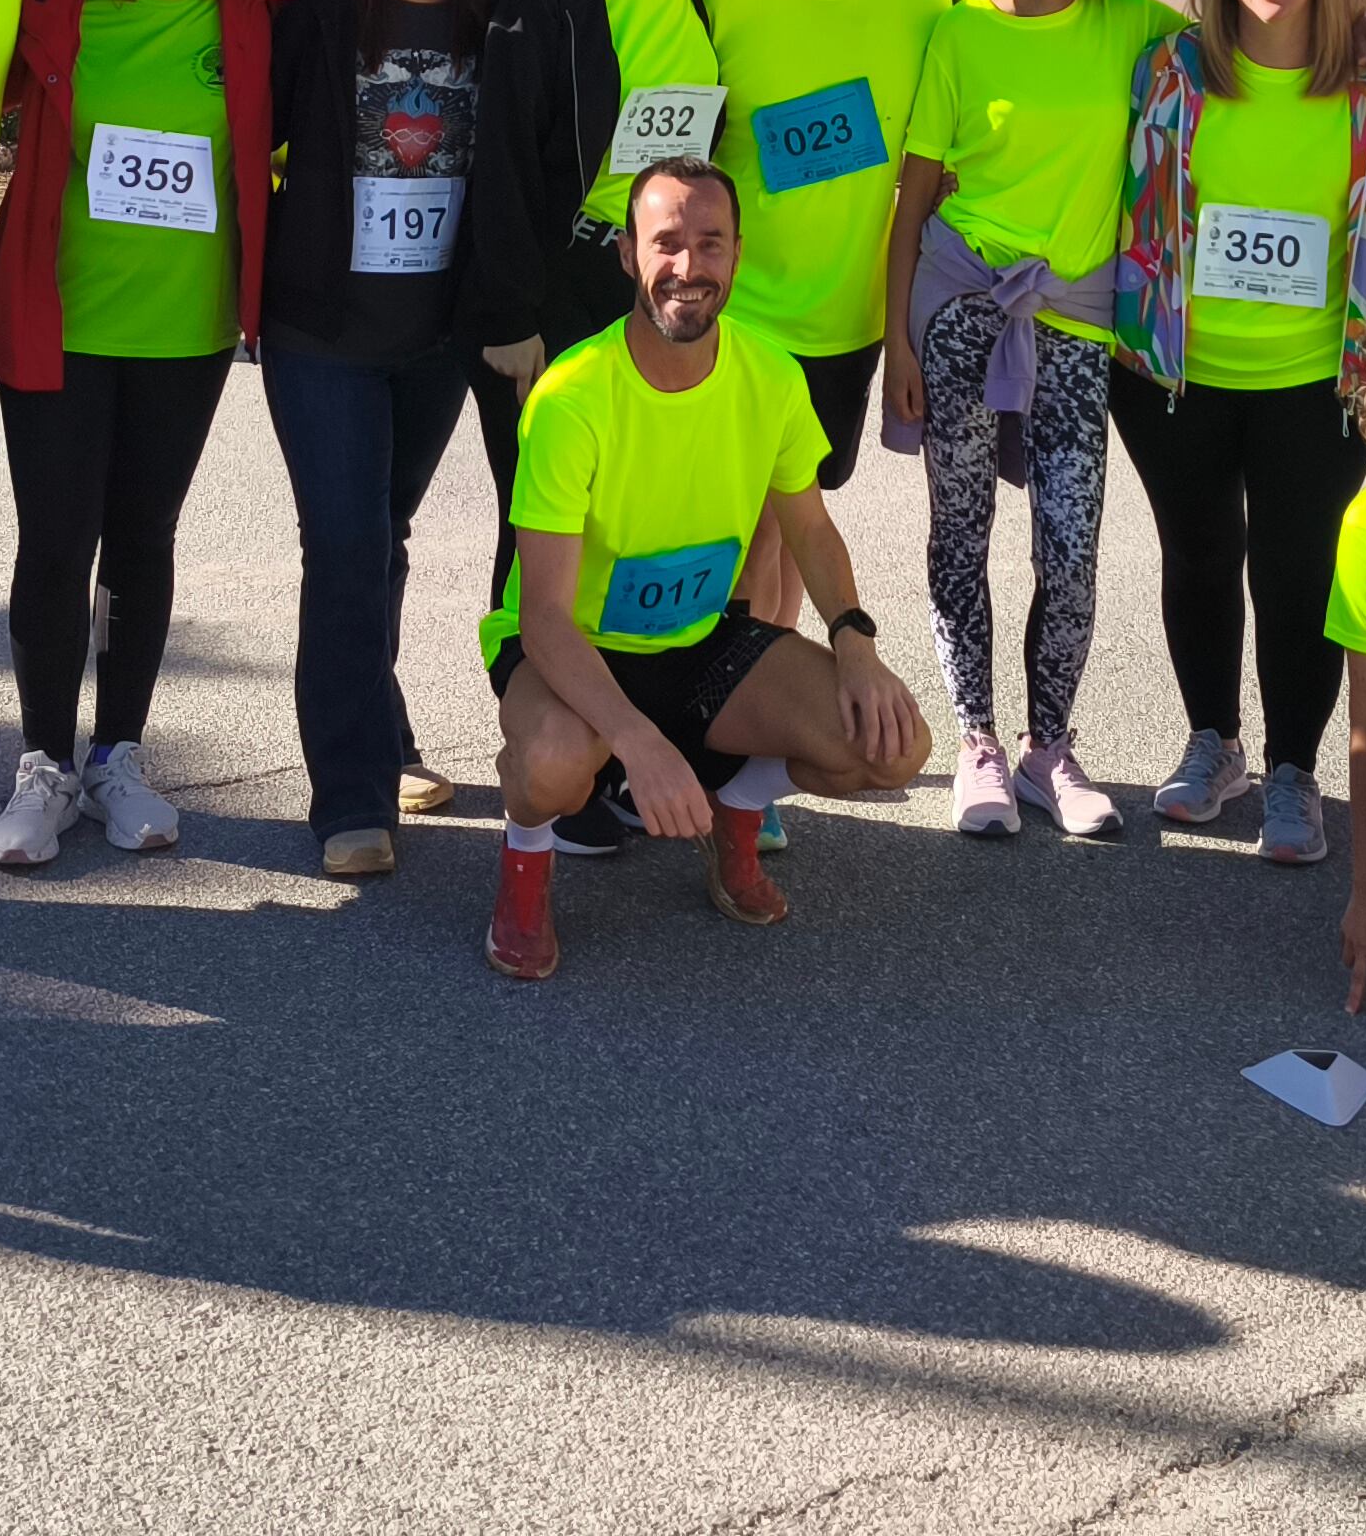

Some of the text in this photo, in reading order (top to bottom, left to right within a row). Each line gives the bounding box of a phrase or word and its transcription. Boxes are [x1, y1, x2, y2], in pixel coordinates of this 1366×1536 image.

[636, 105, 695, 137] 332
[783, 113, 853, 157] 023
[118, 154, 194, 194] 359
[380, 207, 447, 240] 197
[1225, 229, 1301, 268] 350
[638, 568, 712, 609] 017
